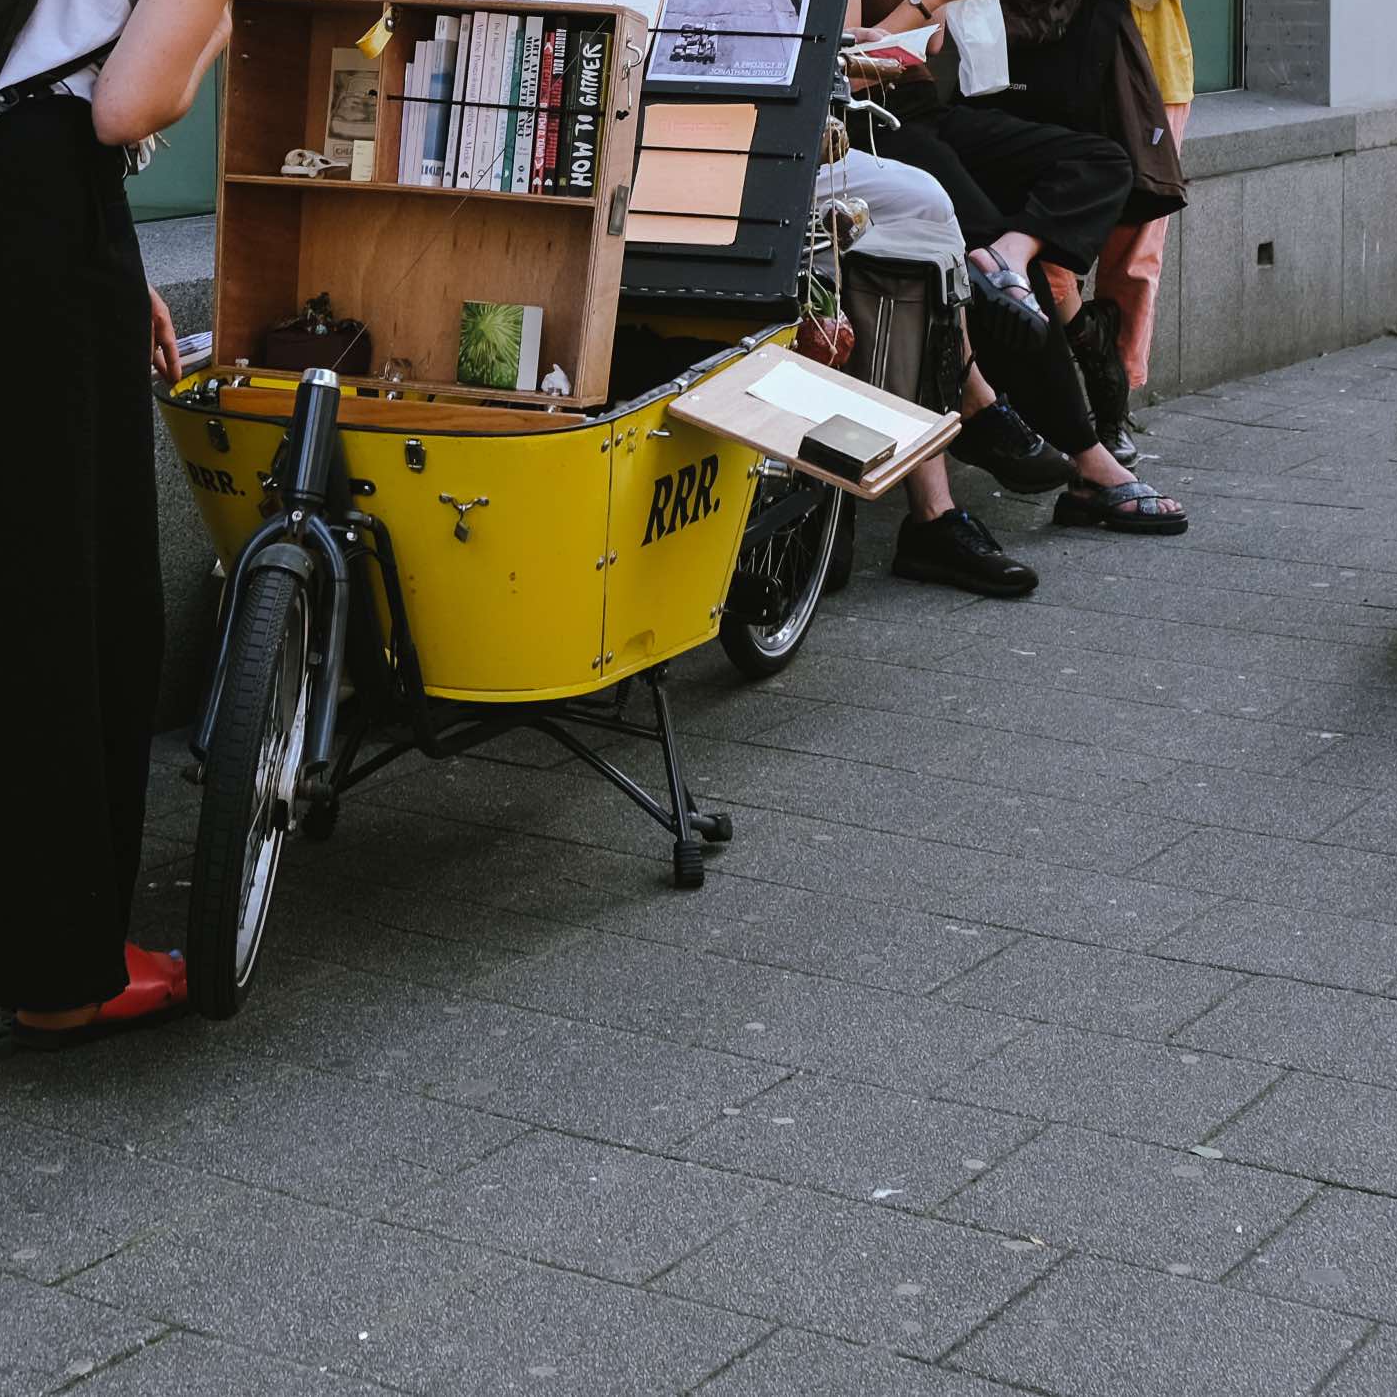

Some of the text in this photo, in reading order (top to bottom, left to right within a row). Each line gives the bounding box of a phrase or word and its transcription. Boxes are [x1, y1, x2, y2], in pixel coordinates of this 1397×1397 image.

[523, 35, 533, 73] MONEY
[531, 37, 540, 58] ART
[553, 28, 567, 57] AUGUSTO
[528, 63, 537, 97] AFTER
[577, 42, 602, 106] GATHER
[573, 114, 595, 138] TO
[569, 141, 596, 187] HOW
[641, 454, 722, 547] RRR.
